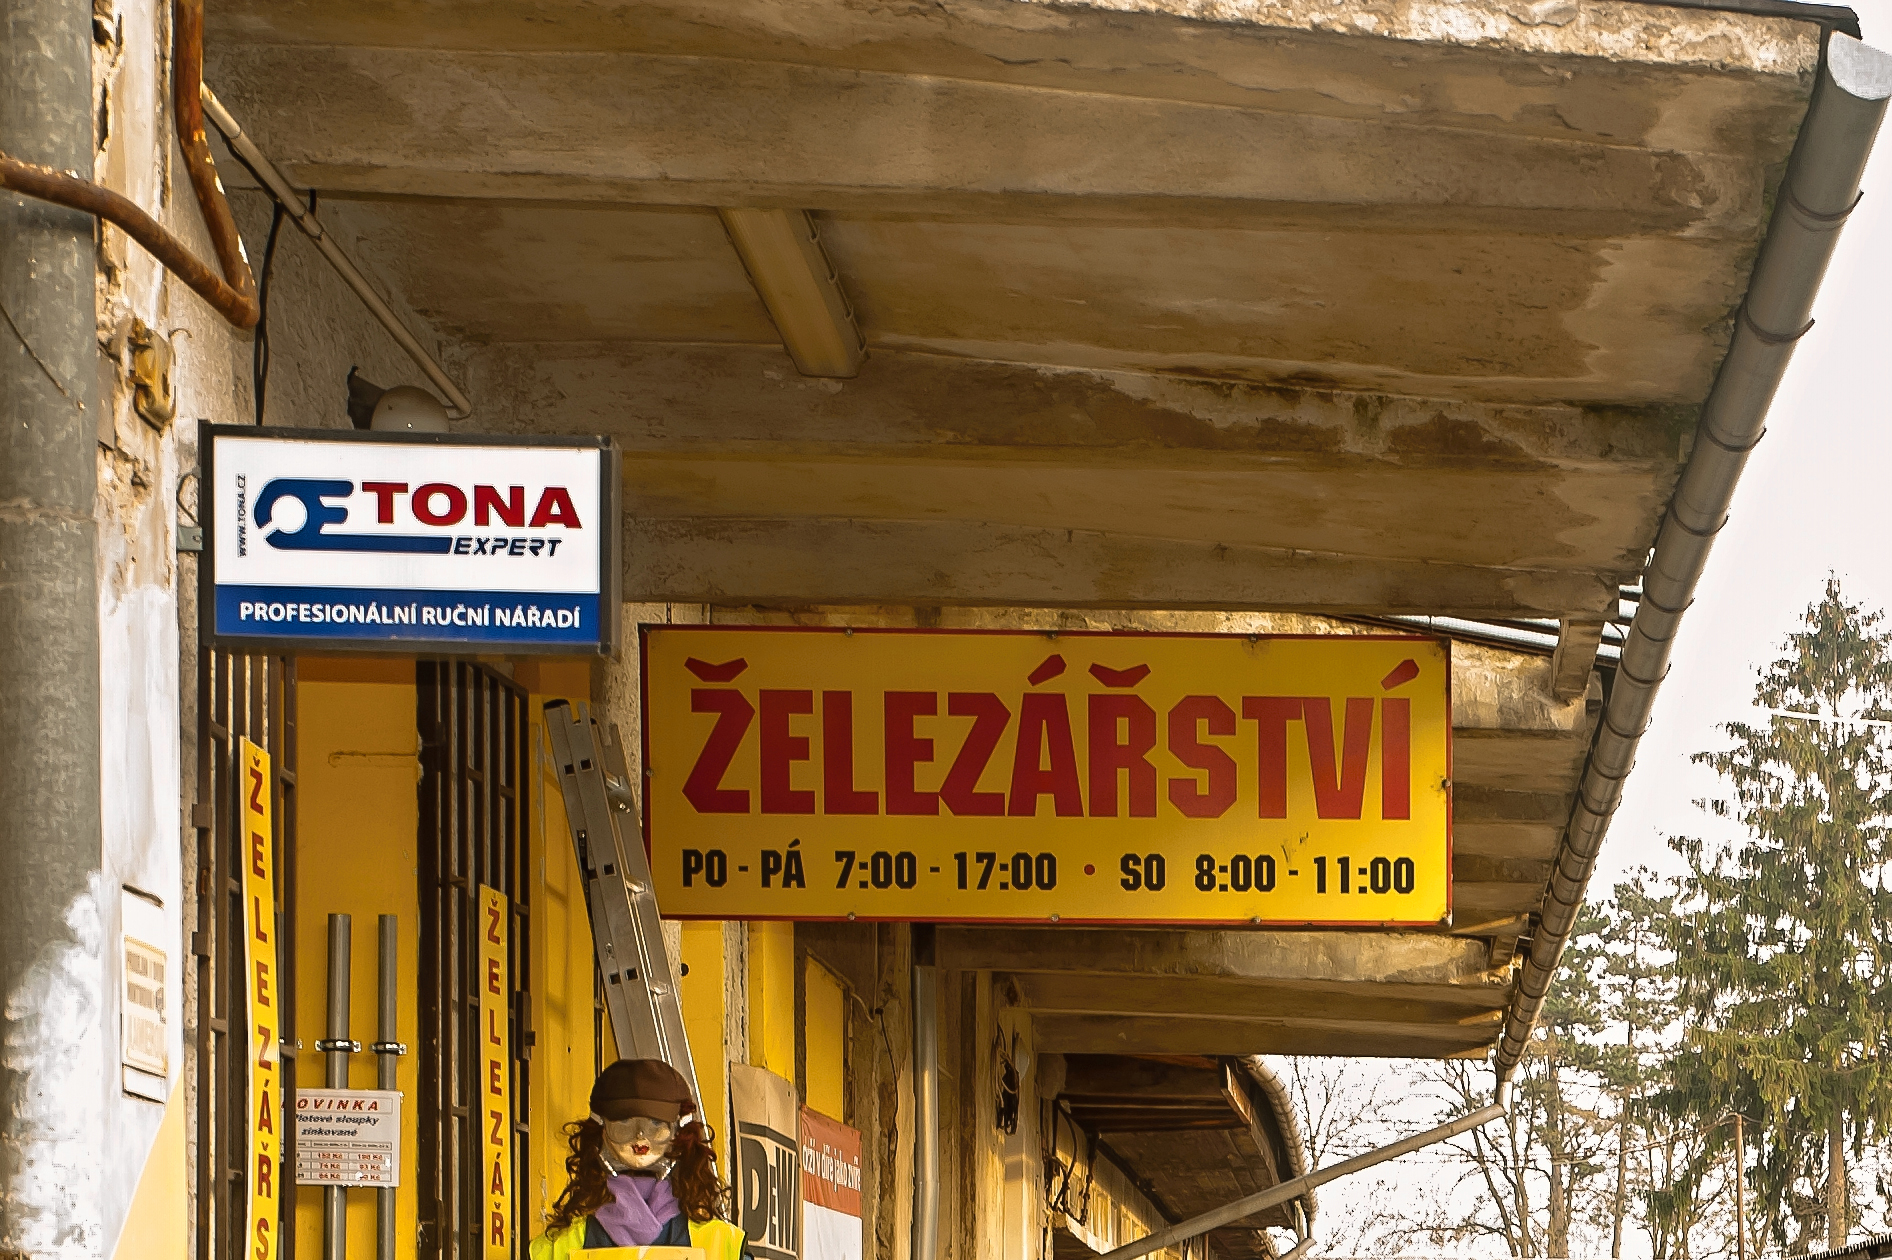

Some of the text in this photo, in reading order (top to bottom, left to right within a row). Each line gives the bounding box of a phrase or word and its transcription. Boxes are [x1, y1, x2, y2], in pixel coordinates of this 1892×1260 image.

[362, 481, 583, 529] TONA
[453, 537, 563, 557] EXPERT
[239, 601, 581, 628] PROFESIONÁLNÍ RUČNÍ NÁŘADÍ
[681, 653, 1421, 822] ŽELEZÁŘSTVÍ
[682, 848, 729, 889] PO
[760, 837, 807, 890] PÁ
[834, 850, 918, 890] 7:00
[953, 852, 1059, 891] 17:00
[1119, 853, 1167, 892] SO
[1194, 854, 1276, 893] 8:00
[1313, 855, 1416, 895] 11:00
[282, 1098, 379, 1111] OVINKA
